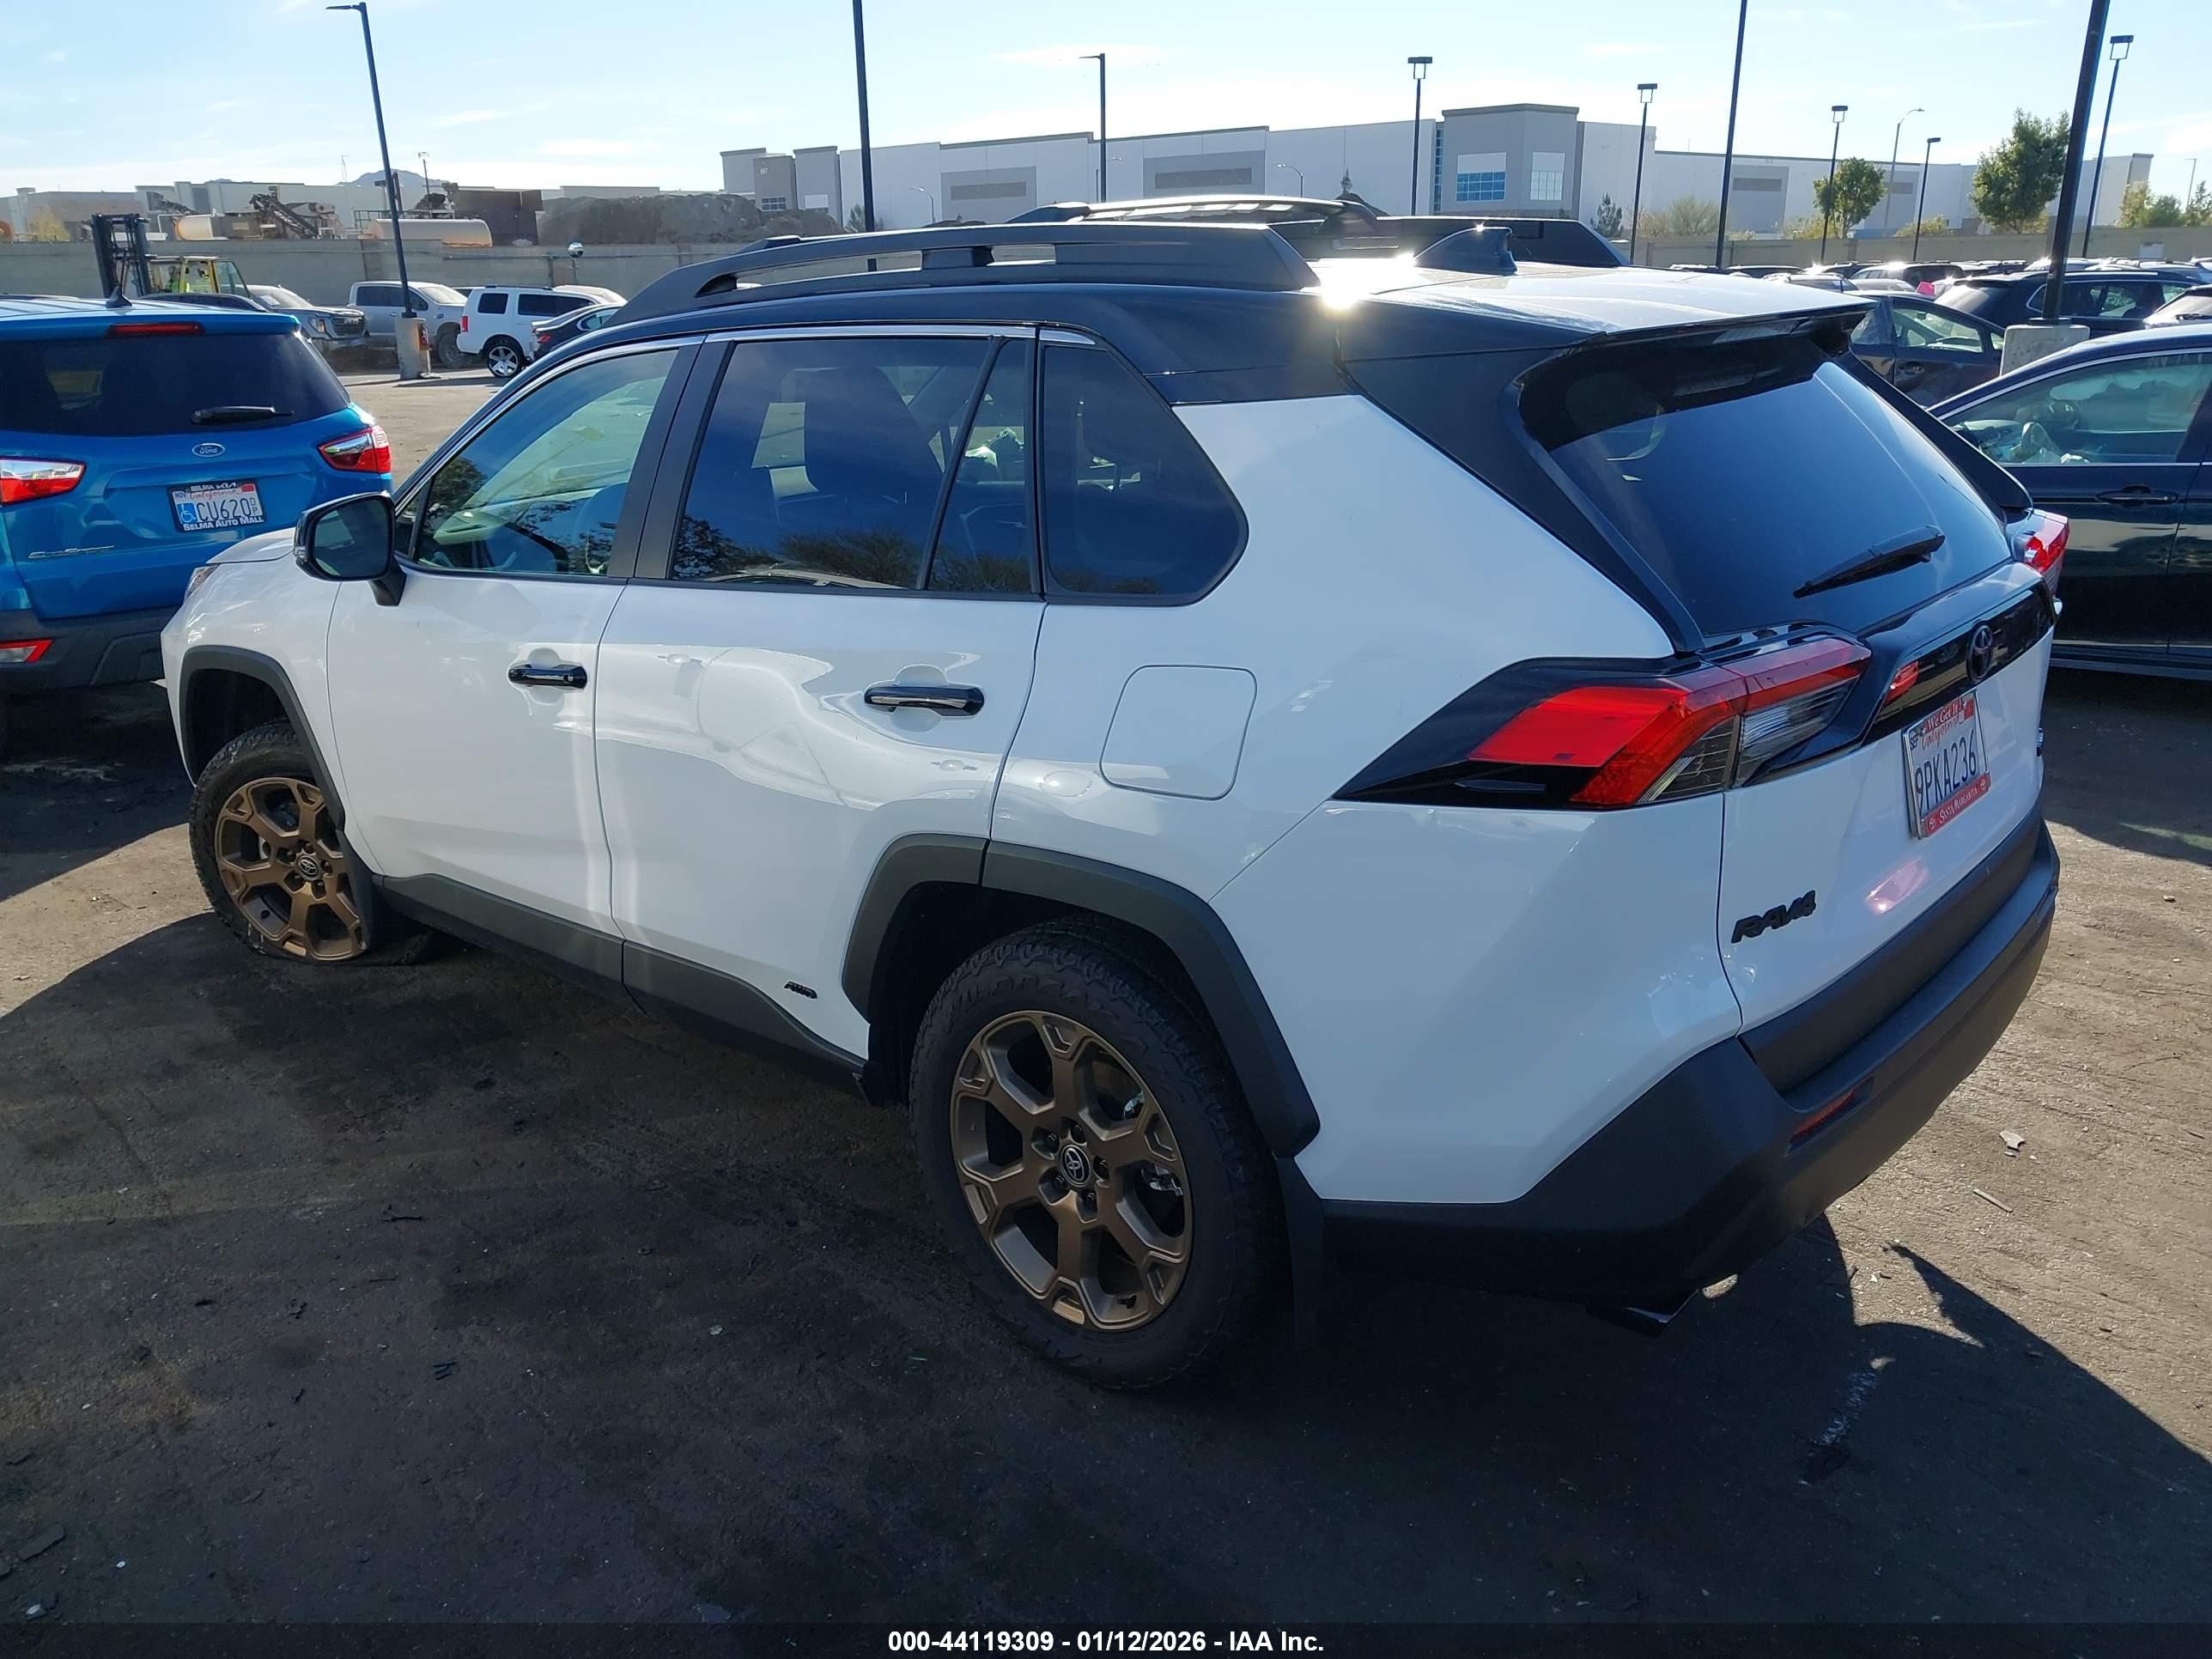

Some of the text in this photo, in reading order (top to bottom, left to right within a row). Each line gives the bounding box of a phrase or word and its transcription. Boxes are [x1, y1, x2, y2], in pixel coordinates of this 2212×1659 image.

[197, 498, 252, 521] CU620
[183, 515, 264, 532] SELMA AUTO MALL
[1941, 707, 1952, 723] Get
[1916, 727, 1977, 817] 9PKA236
[1731, 890, 1816, 944] RAV4
